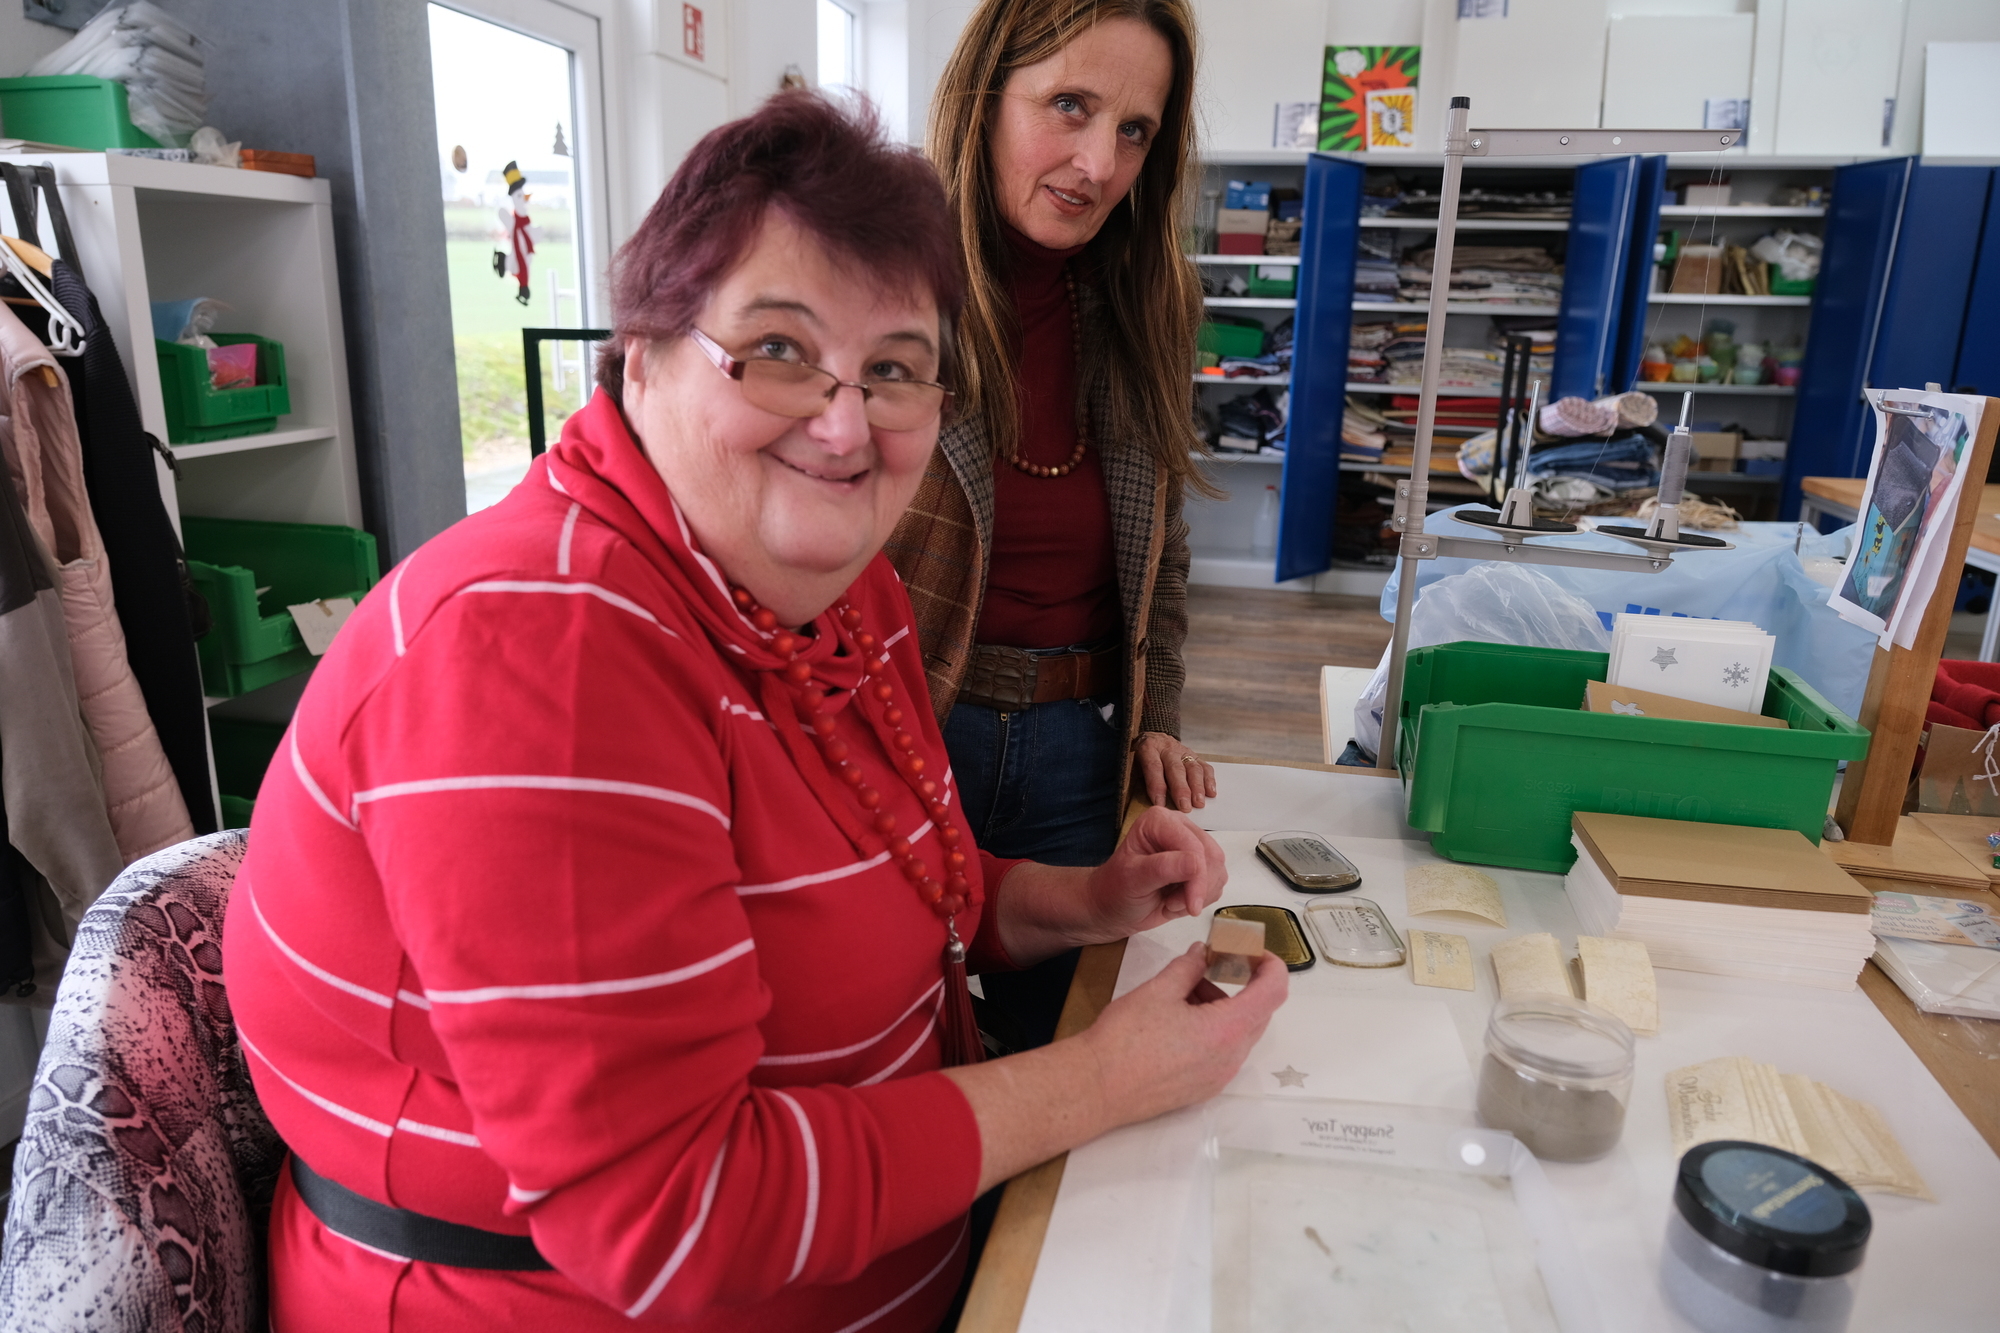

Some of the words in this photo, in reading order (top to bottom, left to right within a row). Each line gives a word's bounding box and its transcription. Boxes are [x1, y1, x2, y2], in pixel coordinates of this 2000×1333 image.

[1523, 779, 1544, 791] SK
[1546, 781, 1577, 795] 3521
[1602, 786, 1711, 823] BITO
[1871, 912, 1937, 925] Klappkarten
[1880, 920, 1898, 928] mit
[1900, 921, 1940, 932] Kuverts
